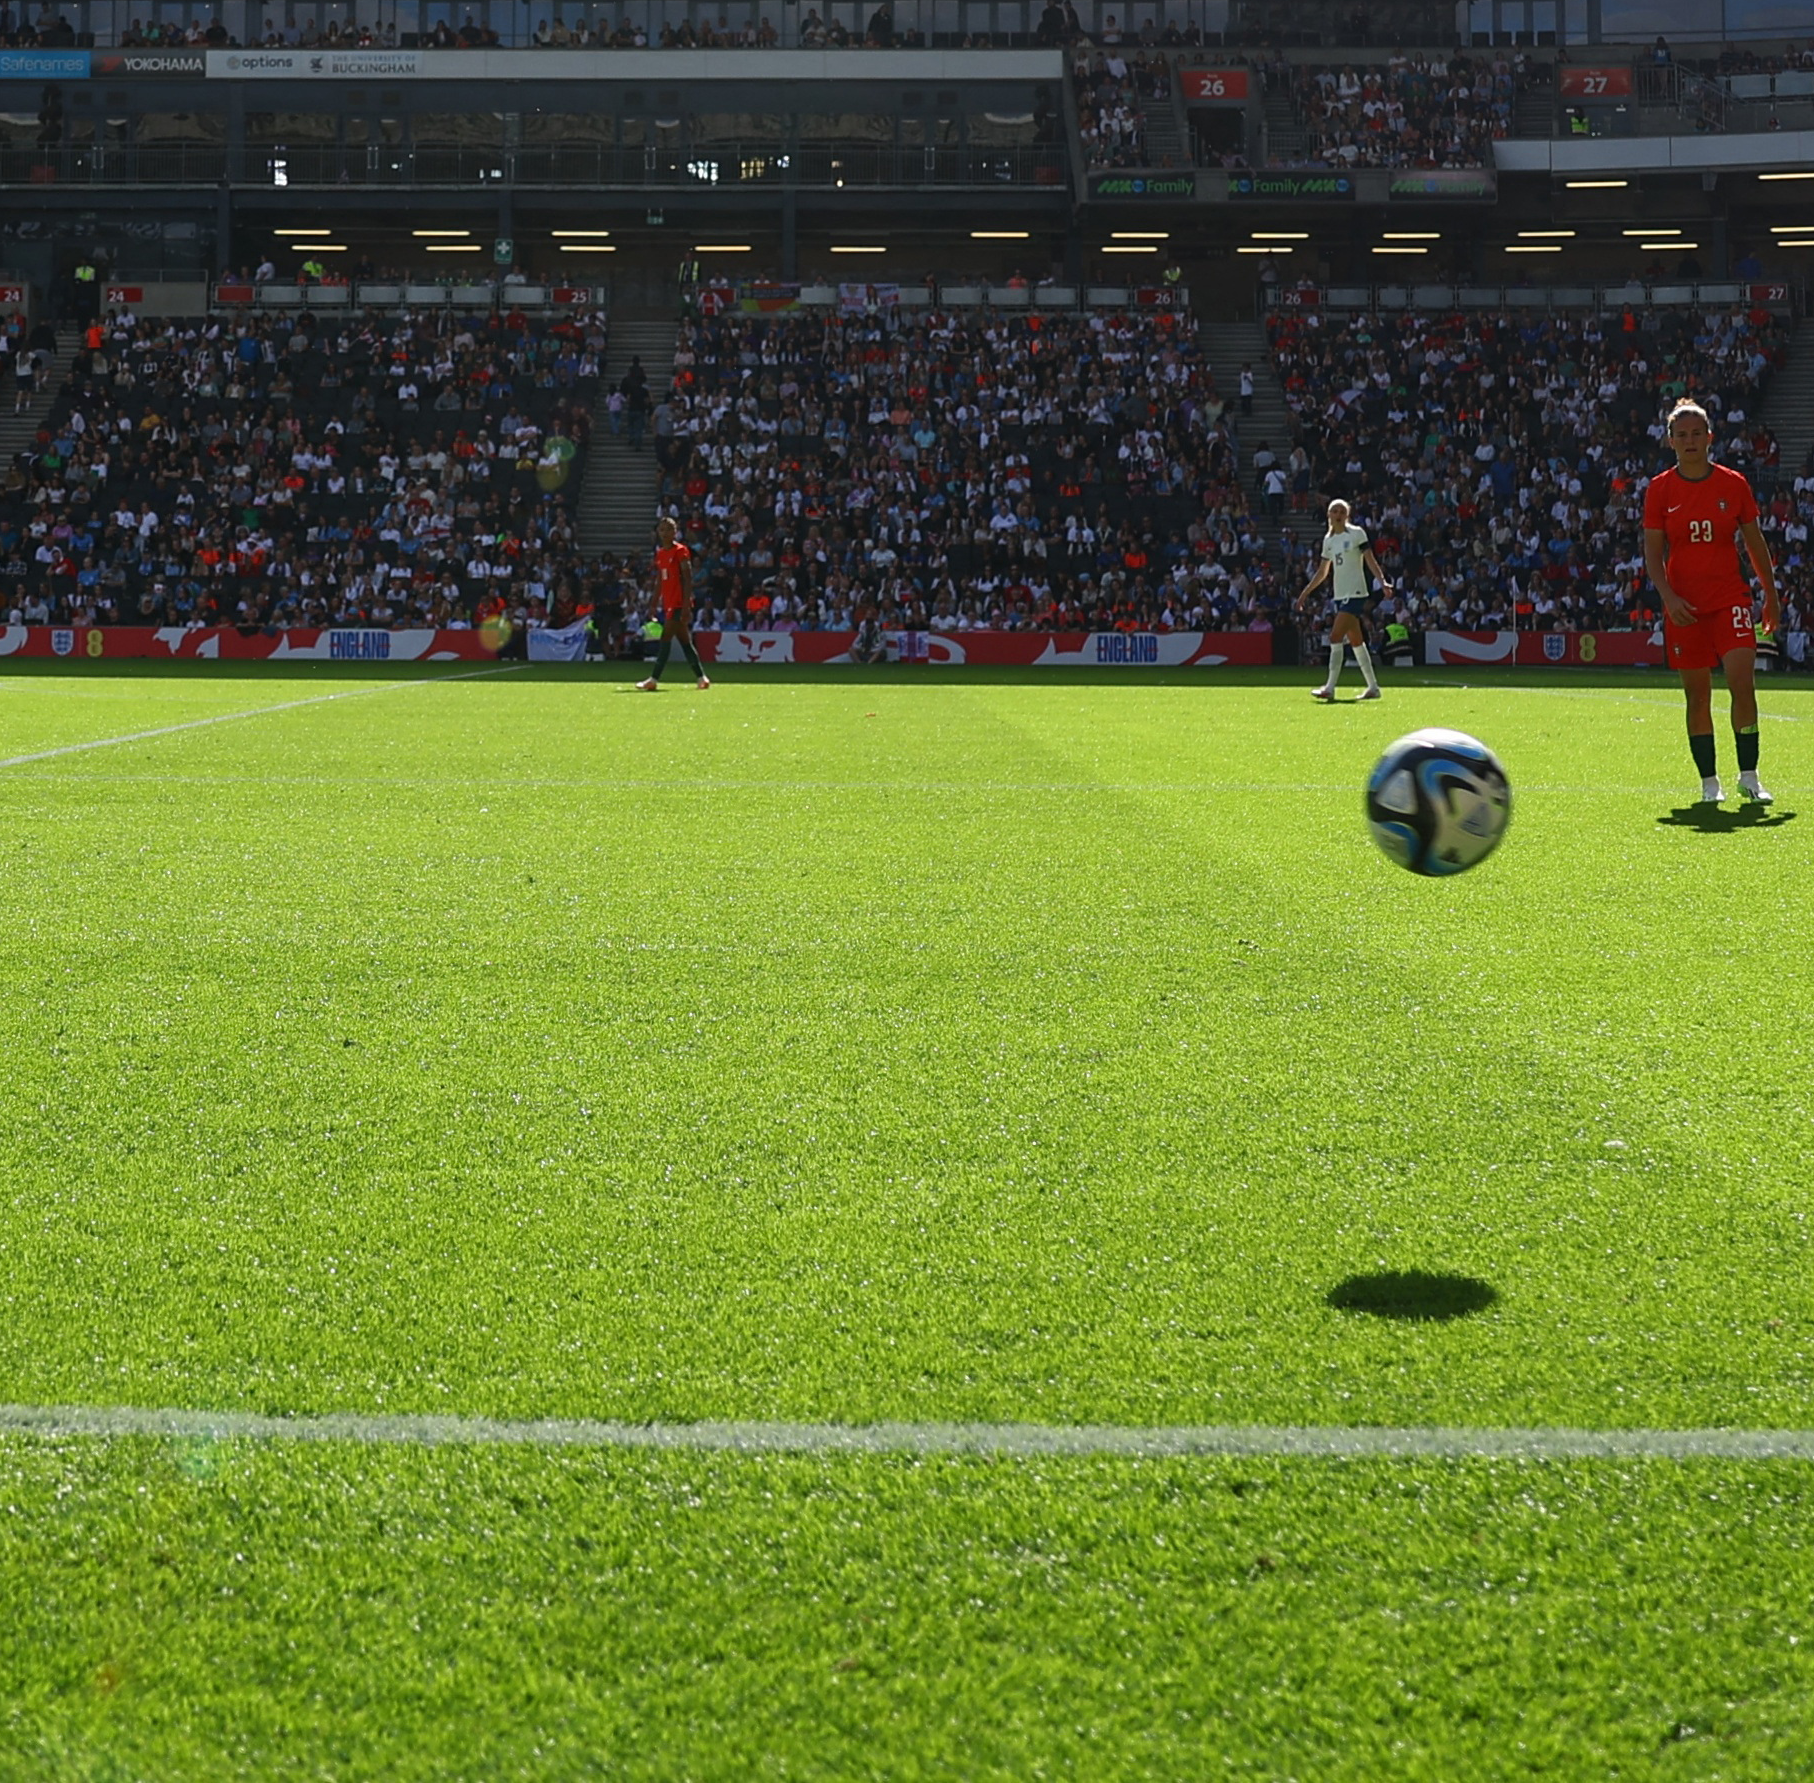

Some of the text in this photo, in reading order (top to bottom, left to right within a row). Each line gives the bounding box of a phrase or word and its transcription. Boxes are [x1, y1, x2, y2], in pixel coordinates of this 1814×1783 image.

[1, 57, 84, 71] Safenames
[124, 58, 204, 71] YOKOHAMA
[242, 56, 293, 70] options
[332, 63, 416, 74] BUCKINGHAM
[1200, 79, 1225, 97] 26
[1583, 76, 1608, 93] 27
[1146, 179, 1194, 196] Family
[1253, 179, 1300, 196] Family
[4, 290, 20, 302] 24
[108, 290, 124, 302] 24
[571, 292, 587, 303] 25
[1155, 293, 1171, 305] 26
[1285, 293, 1301, 305] 26
[1768, 287, 1784, 300] 27
[1690, 520, 1712, 543] 23
[1732, 606, 1753, 629] 23
[330, 631, 390, 659] ENGLAND
[1097, 635, 1158, 663] ENGLAND
